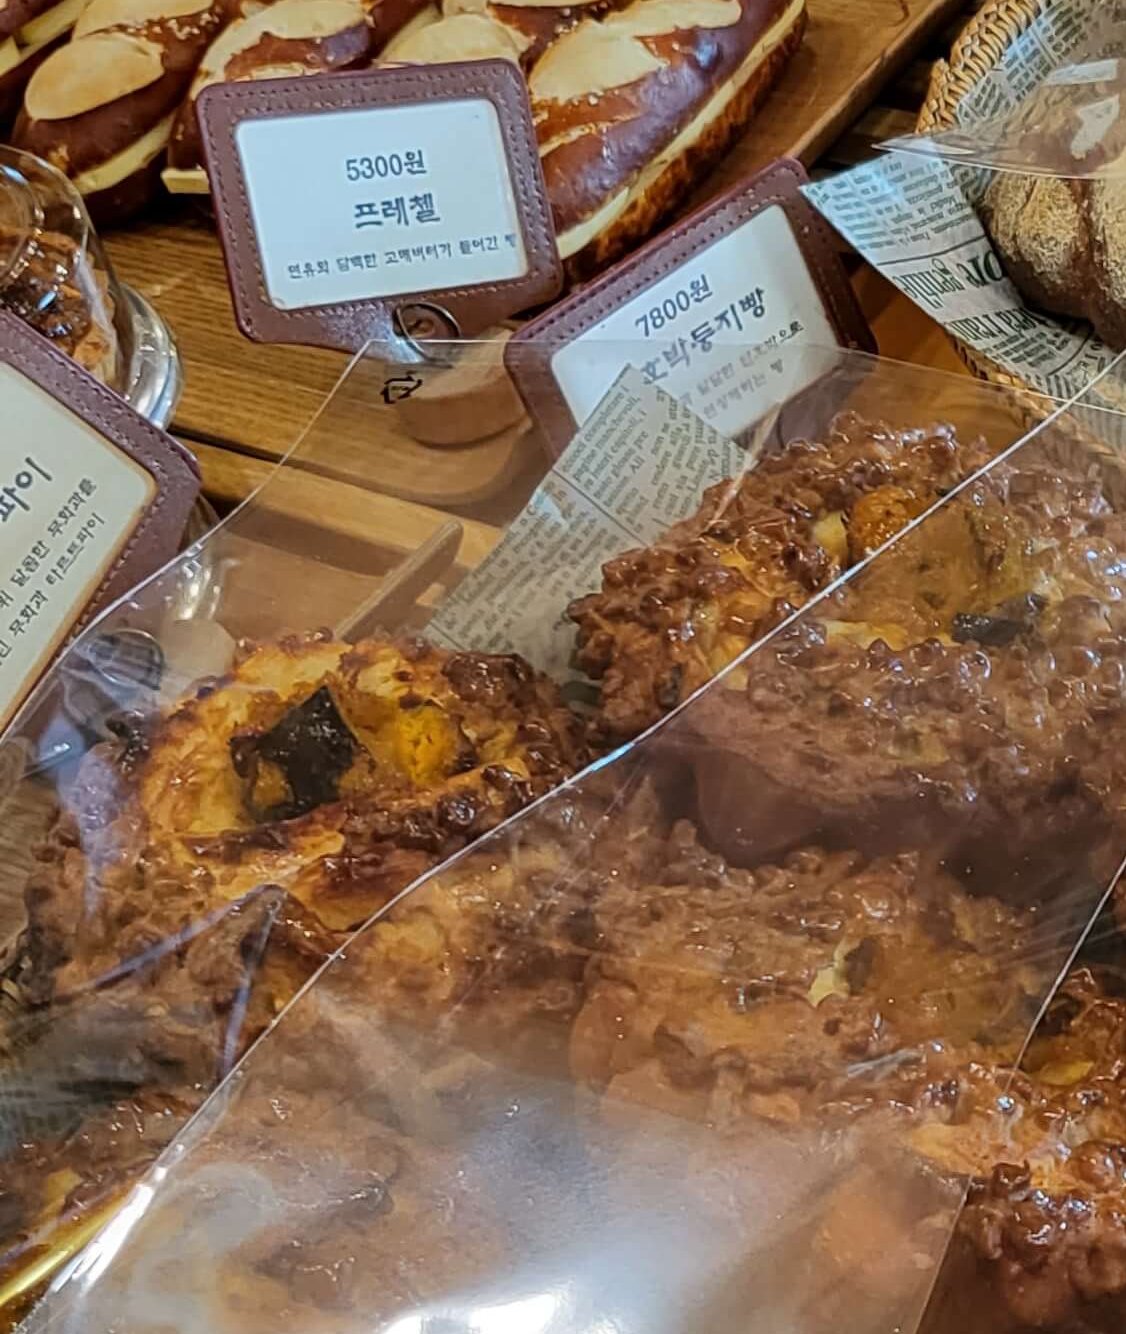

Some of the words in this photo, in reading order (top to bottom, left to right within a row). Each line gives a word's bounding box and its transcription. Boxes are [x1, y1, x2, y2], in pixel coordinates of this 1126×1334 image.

[346, 150, 427, 181] 5300원
[354, 192, 441, 229] 프레첼
[635, 273, 713, 337] 7800원
